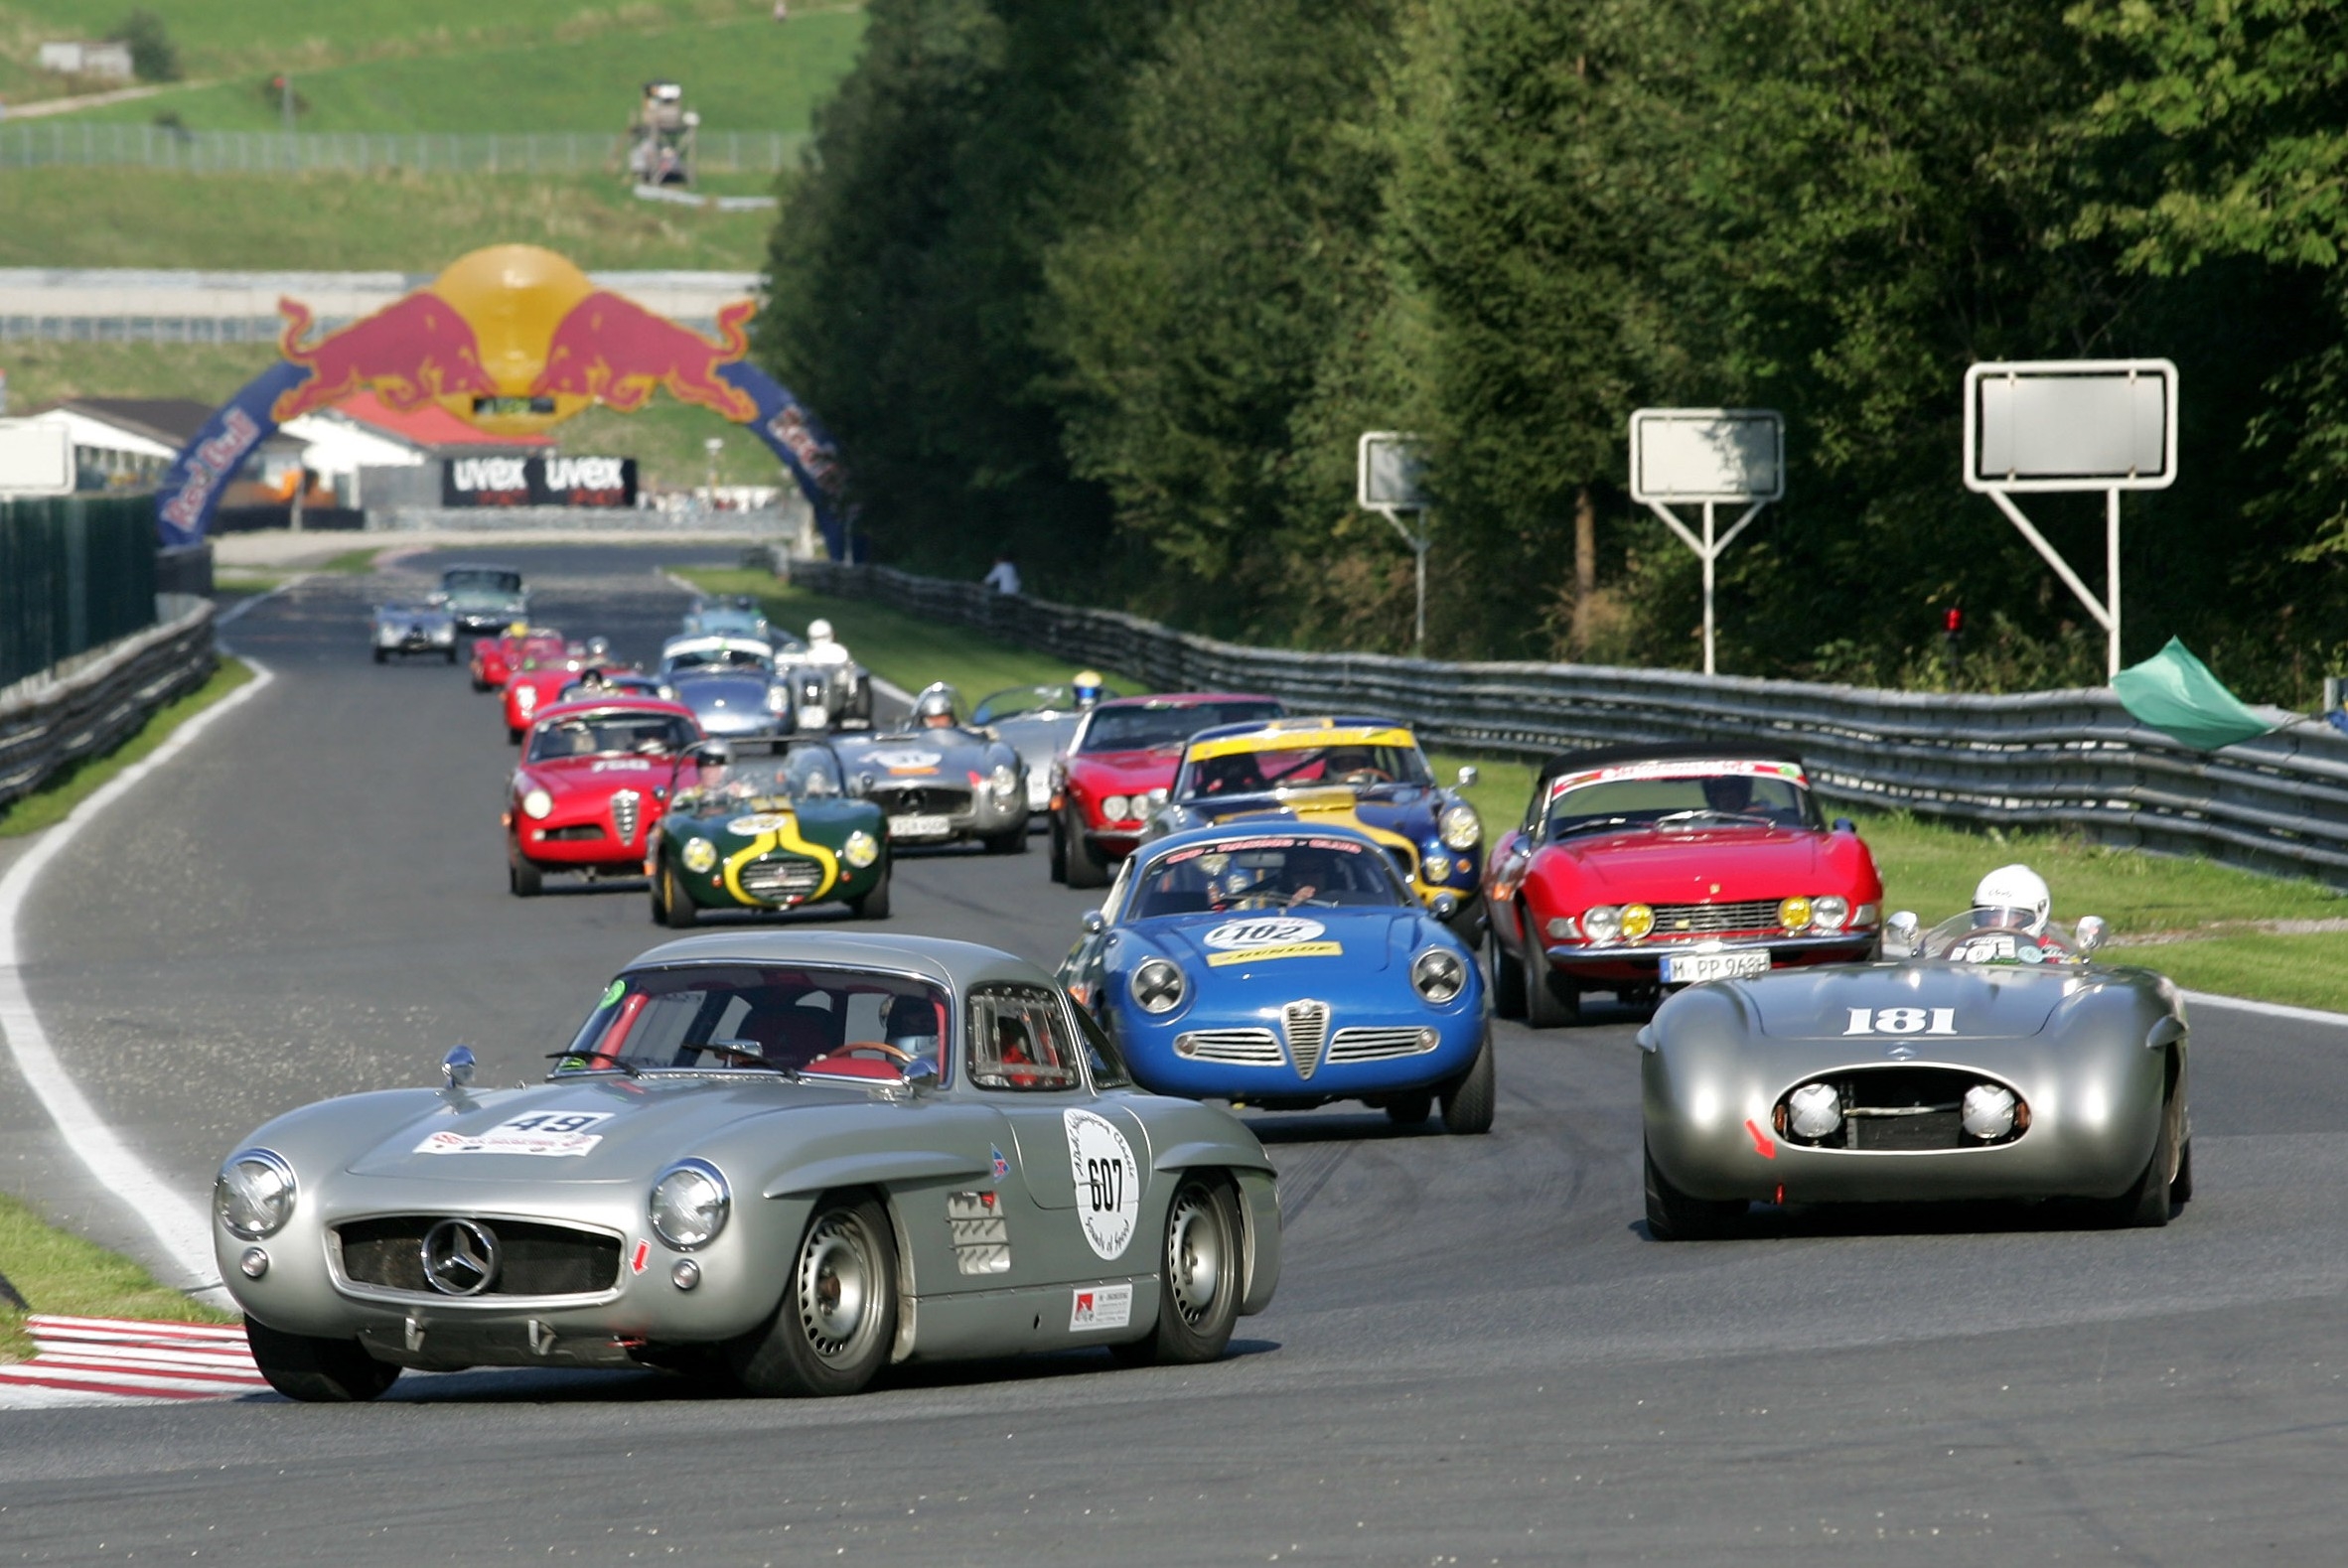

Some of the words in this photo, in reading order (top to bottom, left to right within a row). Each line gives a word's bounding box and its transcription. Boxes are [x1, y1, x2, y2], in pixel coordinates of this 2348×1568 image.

[159, 458, 214, 533] Red
[196, 406, 261, 477] Bull
[454, 456, 526, 491] uvex
[545, 456, 624, 491] uvex
[1232, 924, 1303, 940] 102
[1673, 961, 1686, 979] M
[1696, 959, 1720, 978] PP
[1842, 1007, 1958, 1035] 181
[505, 1114, 598, 1132] 49
[1088, 1158, 1122, 1212] 607
